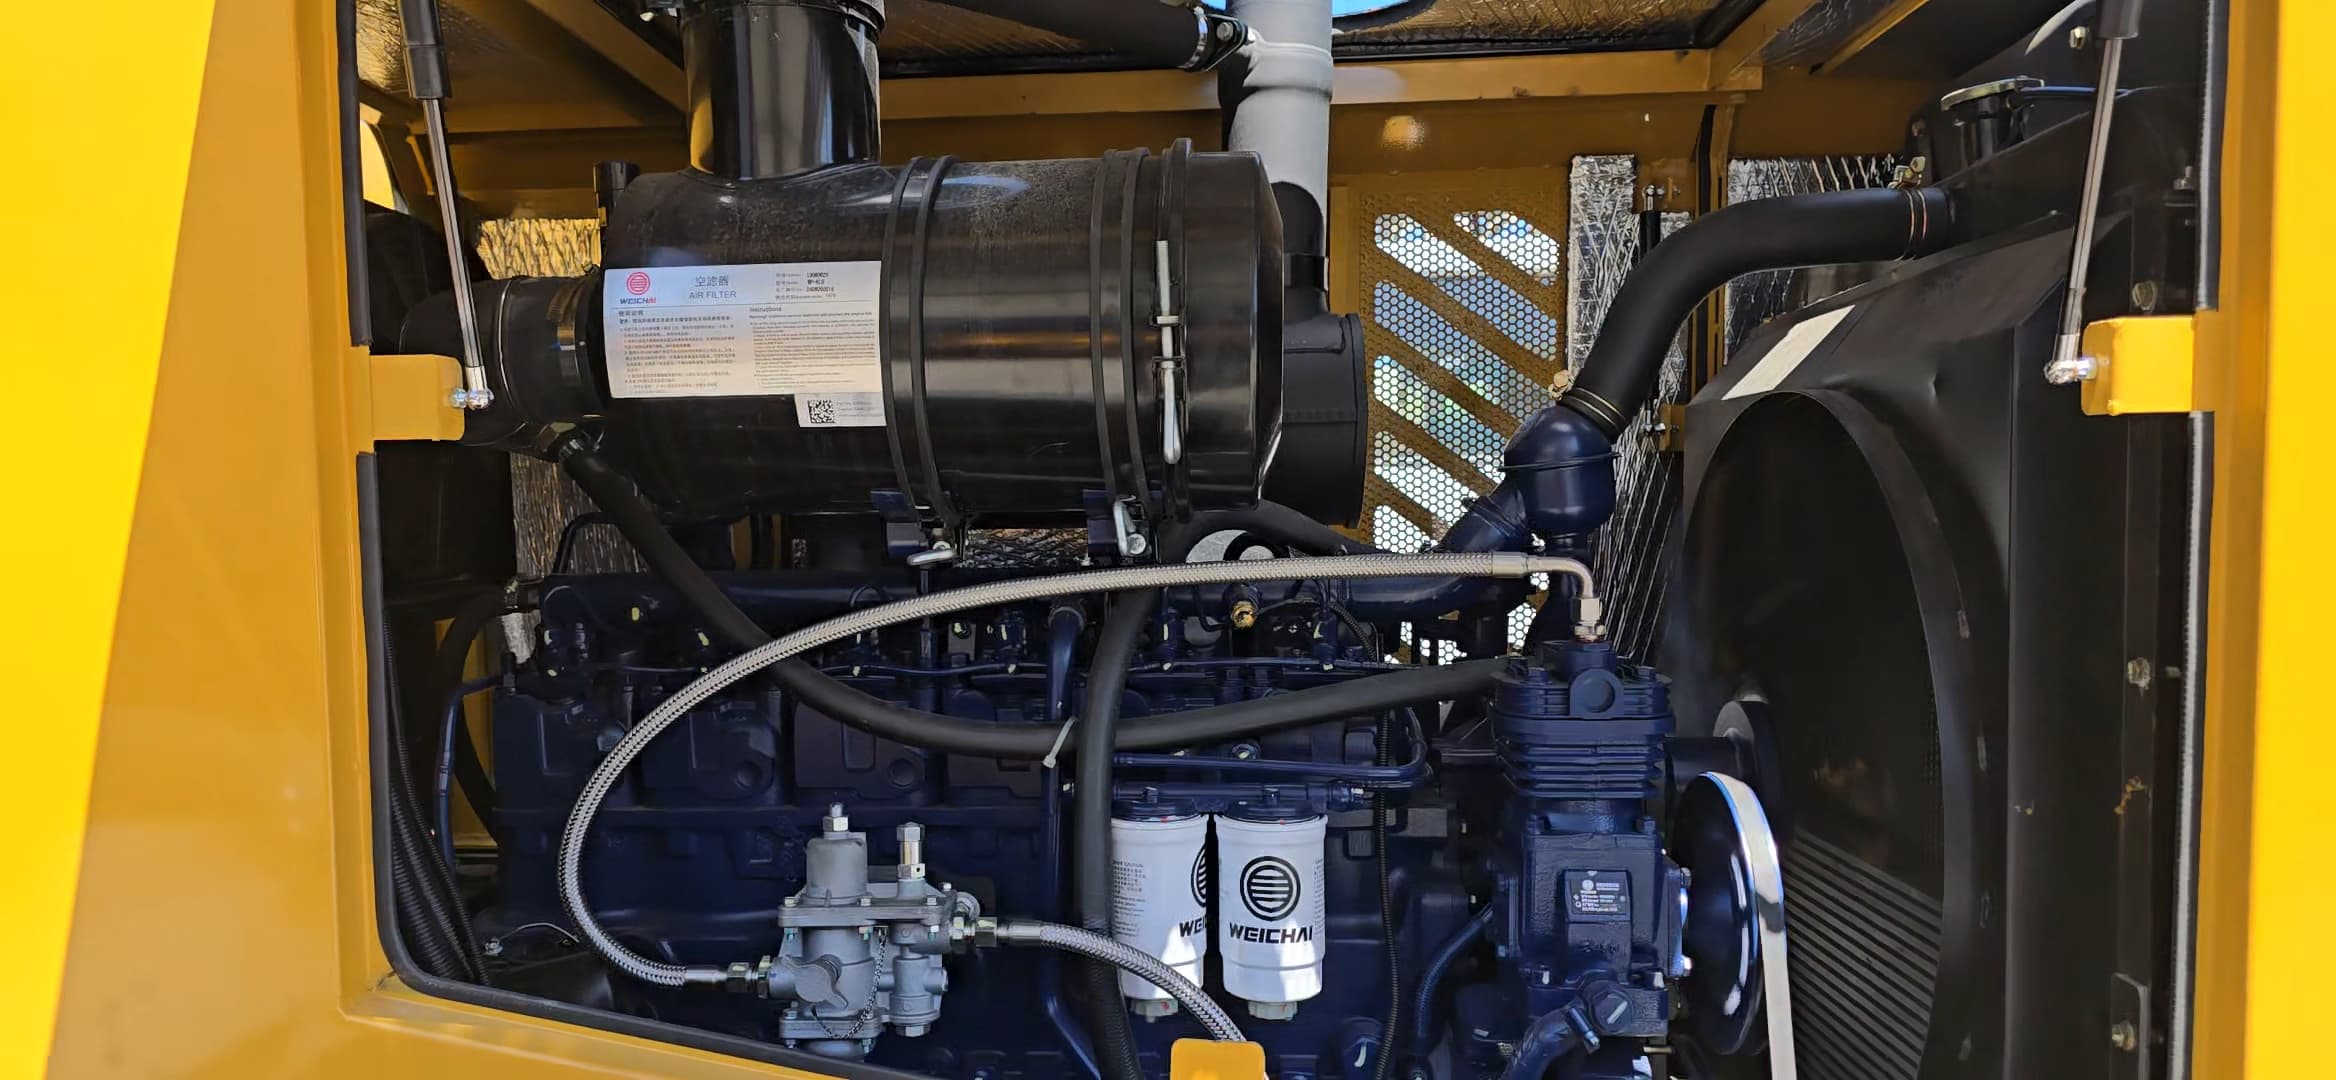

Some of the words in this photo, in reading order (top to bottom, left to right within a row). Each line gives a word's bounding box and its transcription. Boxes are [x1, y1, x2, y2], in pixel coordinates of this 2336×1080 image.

[695, 275, 729, 287] 空滤器
[689, 291, 704, 300] AIR
[706, 290, 737, 299] FILTER
[619, 297, 657, 305] WEICHAI
[1229, 921, 1313, 944] WEICHAI
